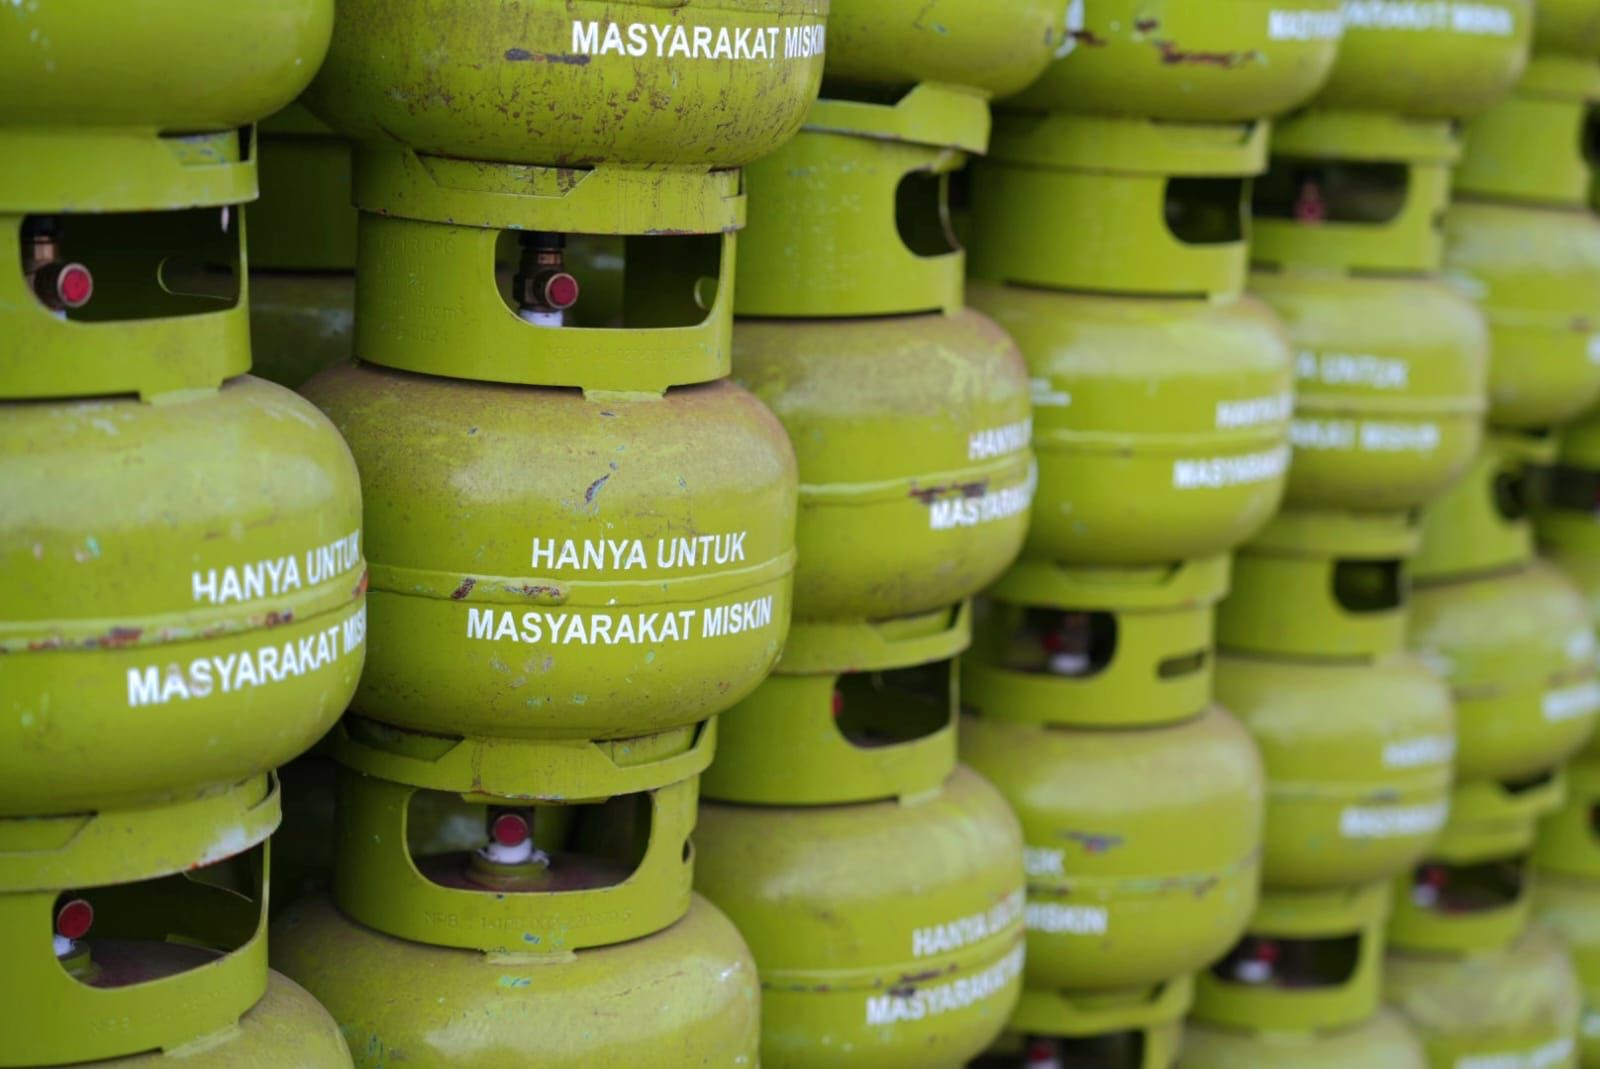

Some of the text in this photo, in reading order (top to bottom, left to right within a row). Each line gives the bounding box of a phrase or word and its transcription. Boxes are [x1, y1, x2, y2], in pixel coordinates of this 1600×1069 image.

[572, 20, 779, 60] MASYARAKAT
[192, 529, 359, 604] HANYA UNTUK
[532, 532, 746, 569] HANYA UNTUK
[467, 596, 772, 644] MASYARAKAT MISKIN
[127, 626, 339, 706] MASYARAKAT
